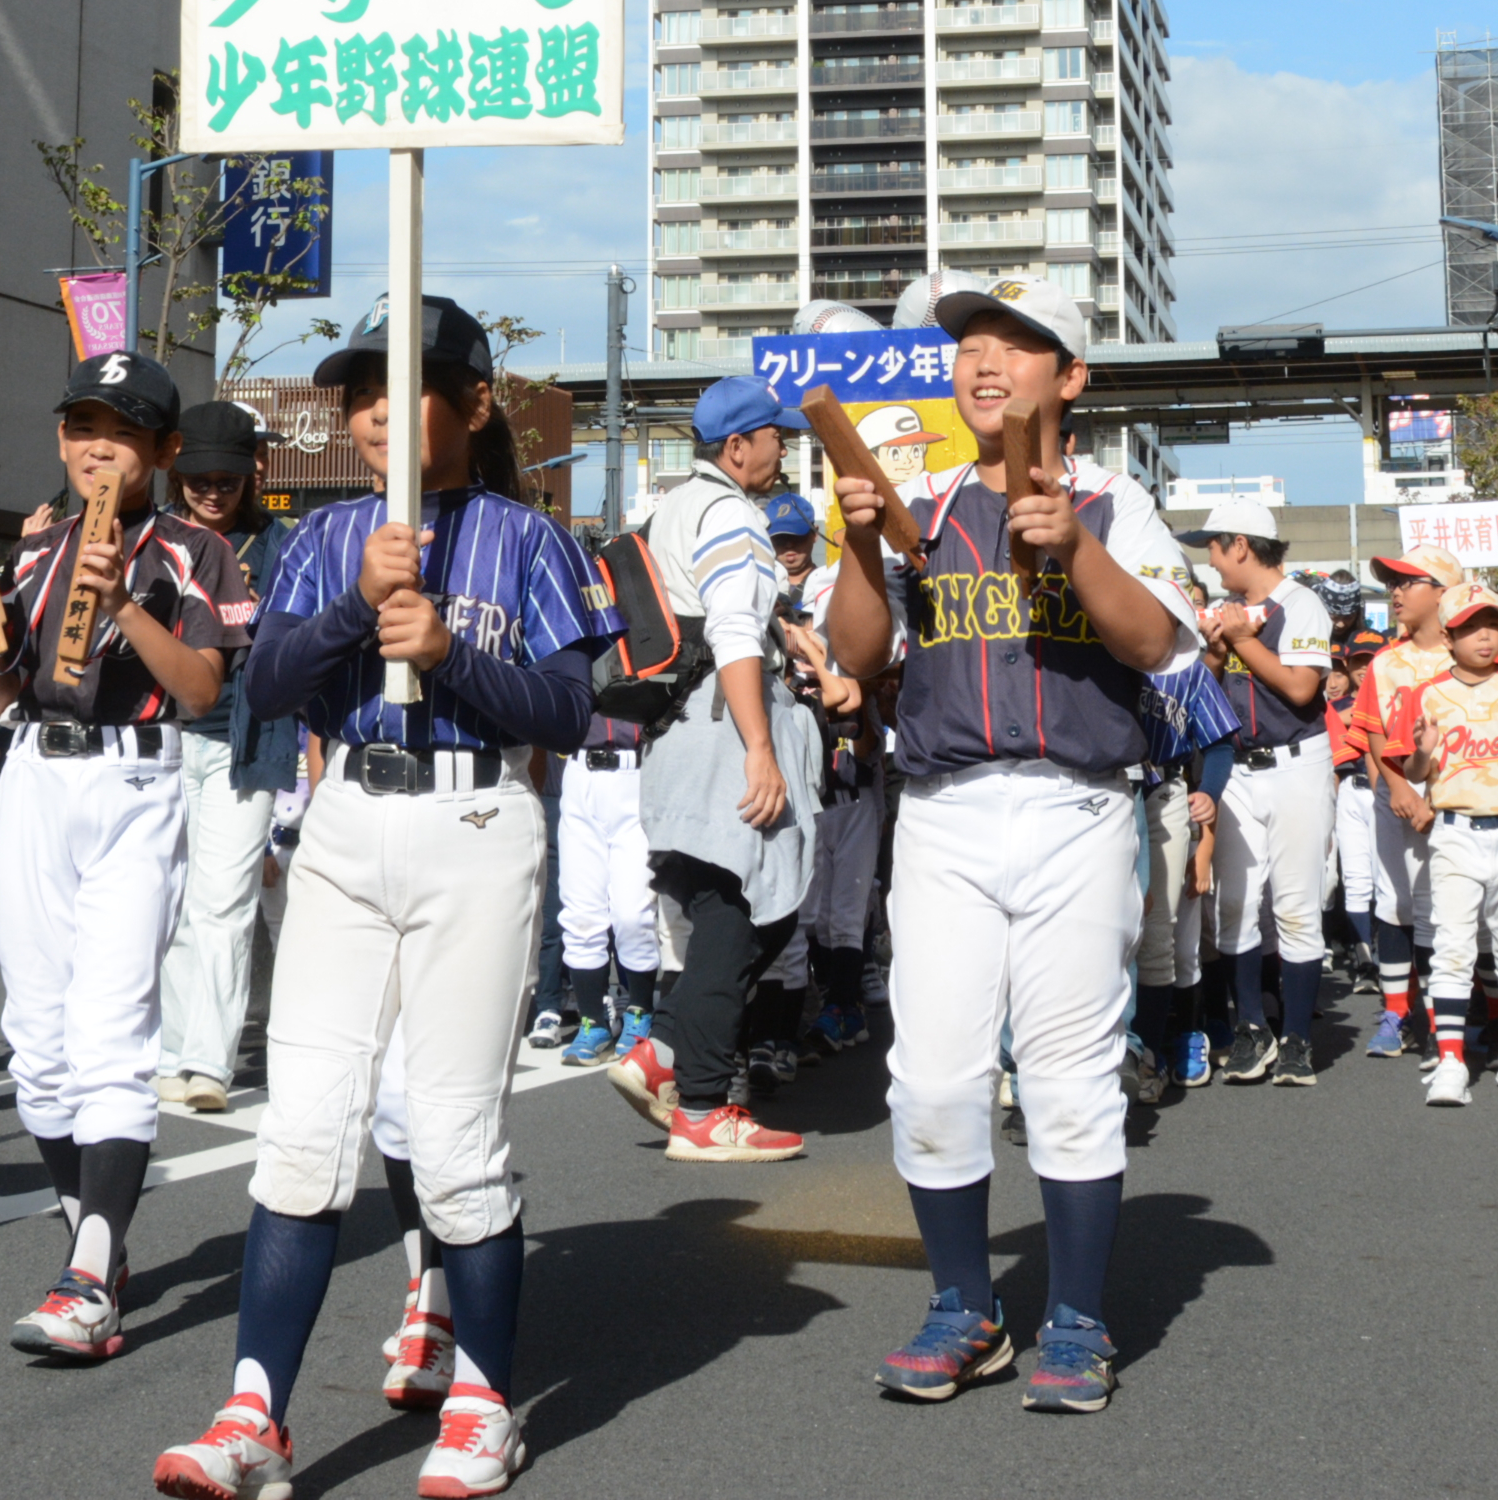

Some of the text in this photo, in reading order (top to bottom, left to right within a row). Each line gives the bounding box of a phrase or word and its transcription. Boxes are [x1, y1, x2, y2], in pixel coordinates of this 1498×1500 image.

[206, 20, 602, 133] 少年野球連盟
